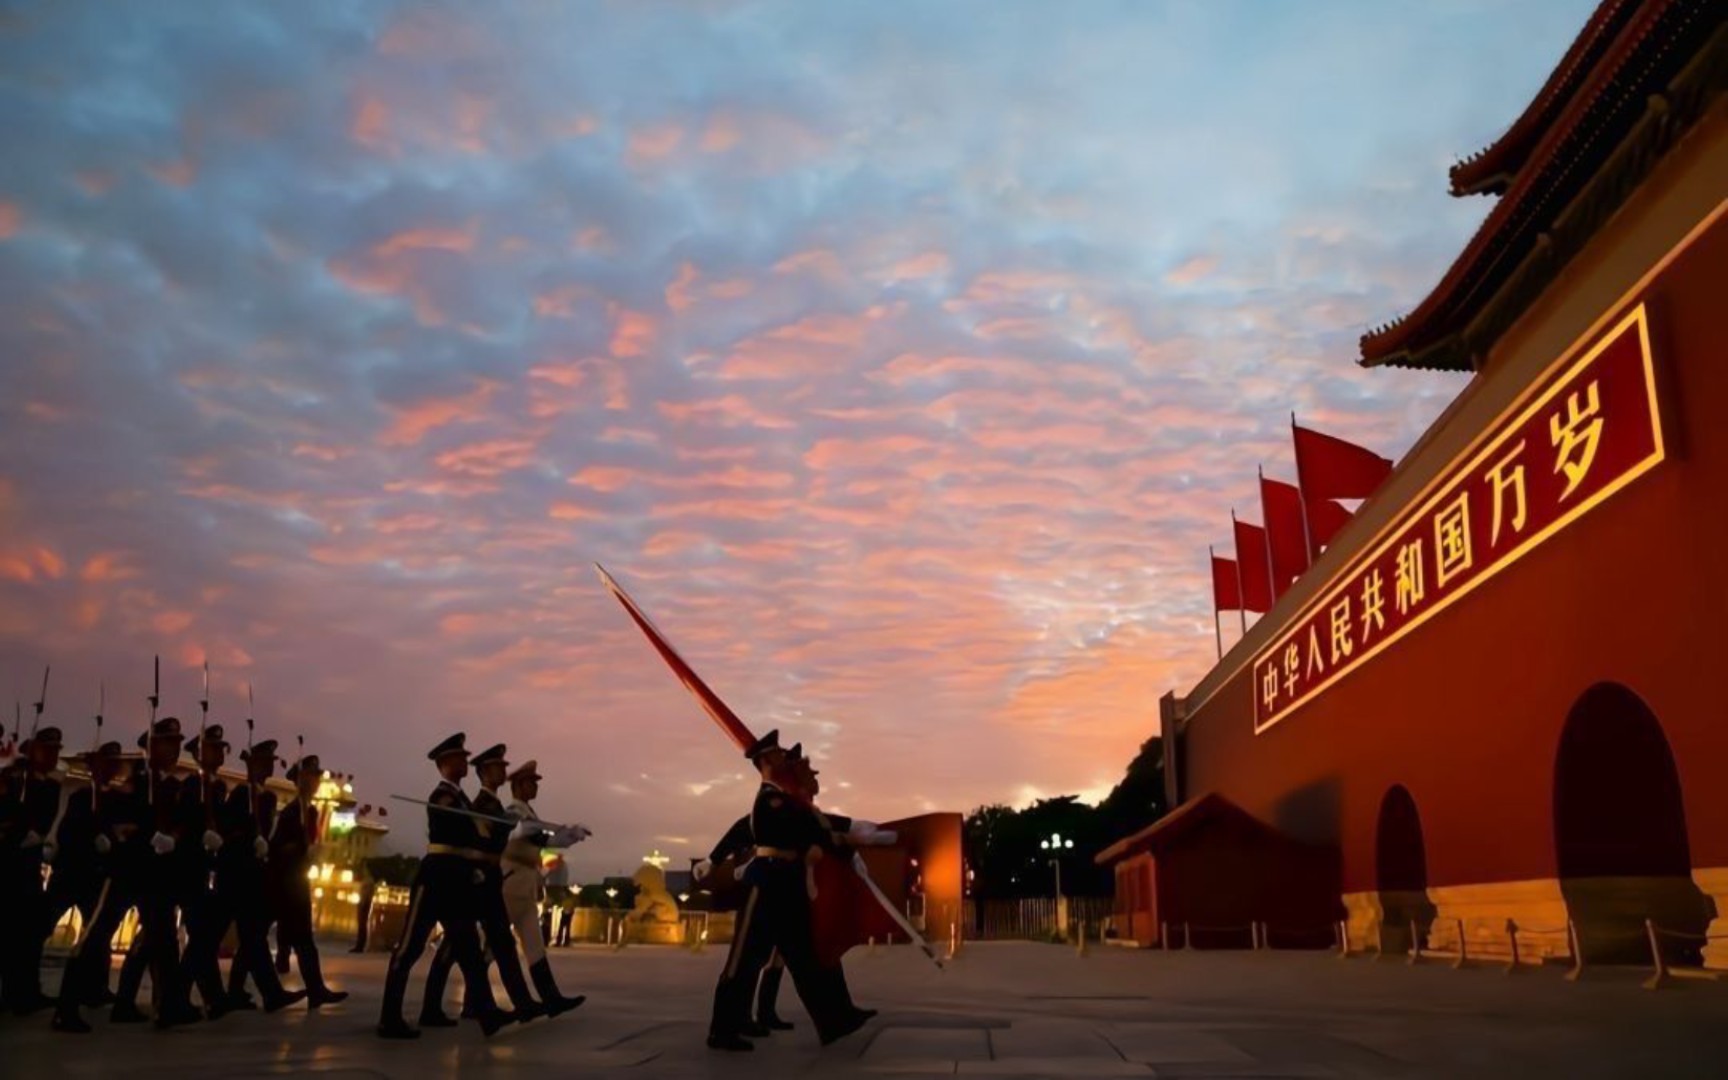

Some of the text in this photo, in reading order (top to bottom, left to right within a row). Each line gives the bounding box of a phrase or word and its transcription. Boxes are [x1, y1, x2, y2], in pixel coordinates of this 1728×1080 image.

[1263, 380, 1604, 712] 中华人民共和国万岁
